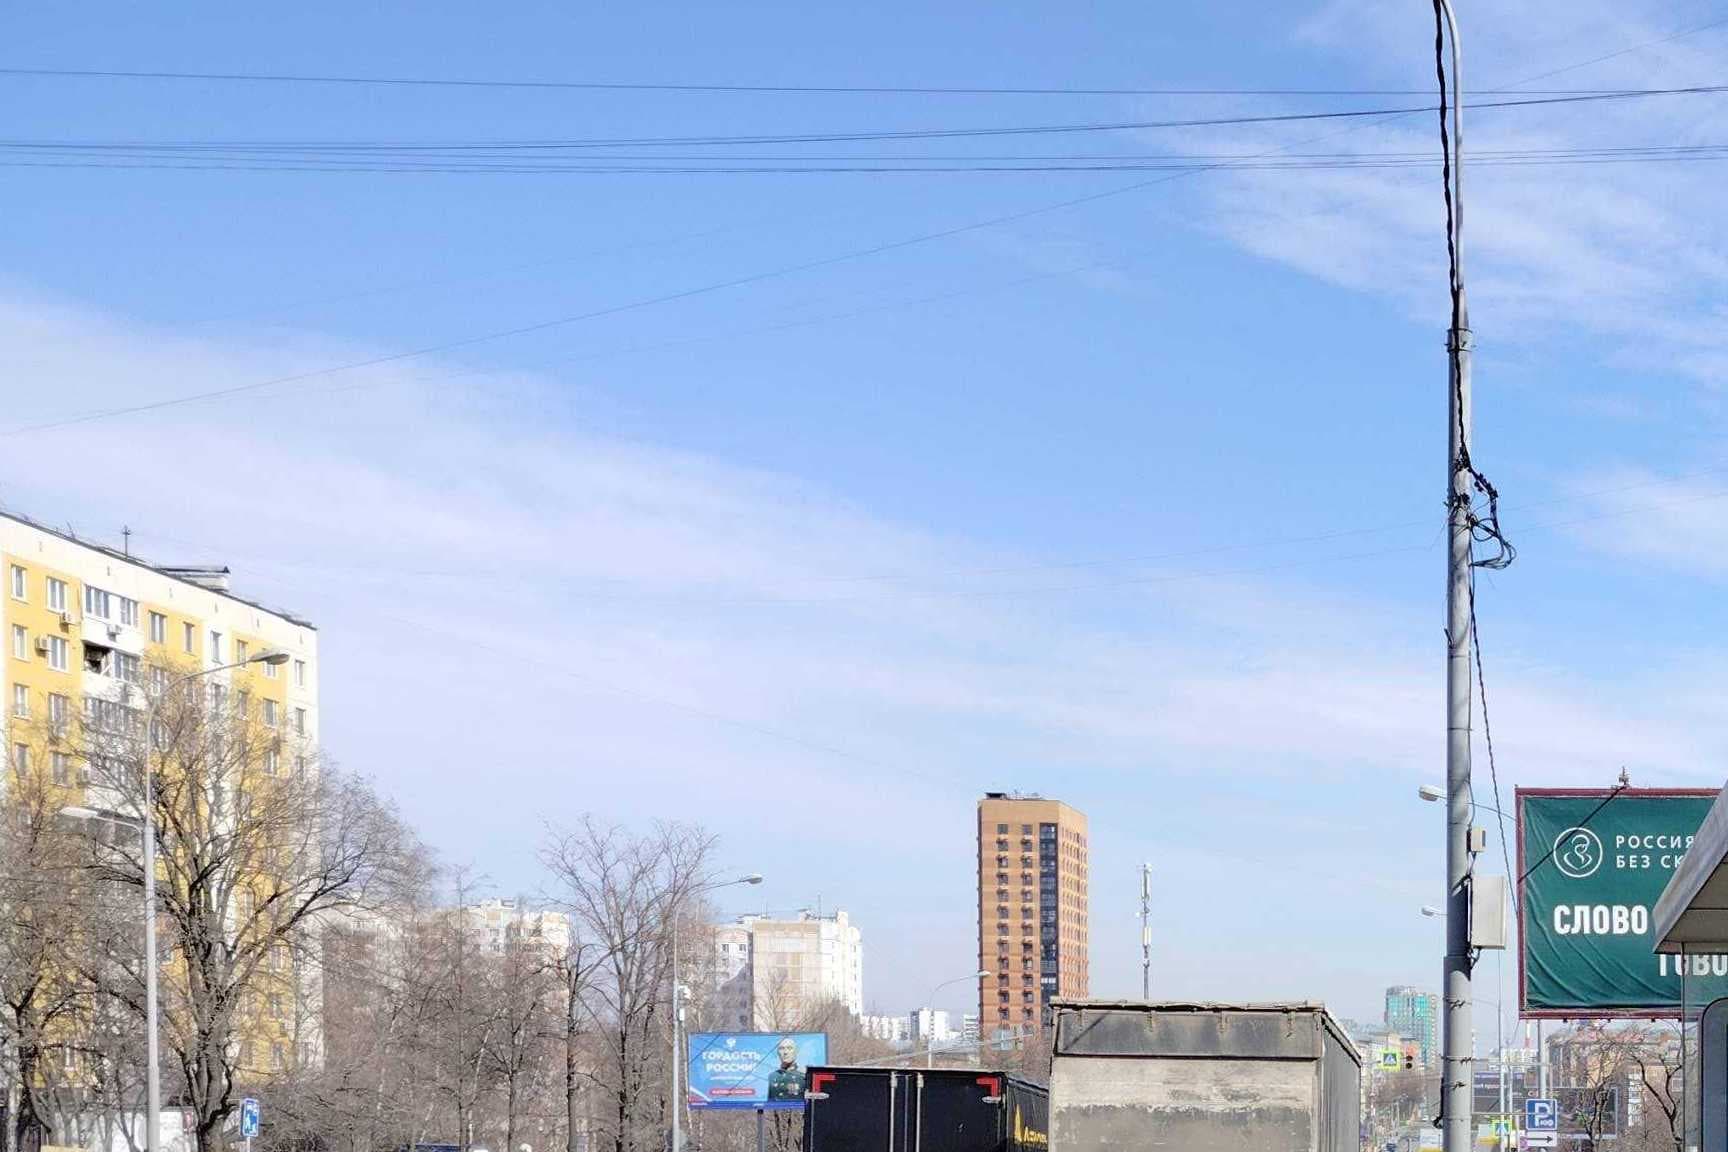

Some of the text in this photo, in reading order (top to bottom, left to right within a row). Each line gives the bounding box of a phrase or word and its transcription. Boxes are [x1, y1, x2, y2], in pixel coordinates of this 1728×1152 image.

[1616, 835, 1695, 849] РОССИЯ
[1616, 855, 1650, 868] БЕЗ
[1554, 905, 1648, 935] СЛОВО
